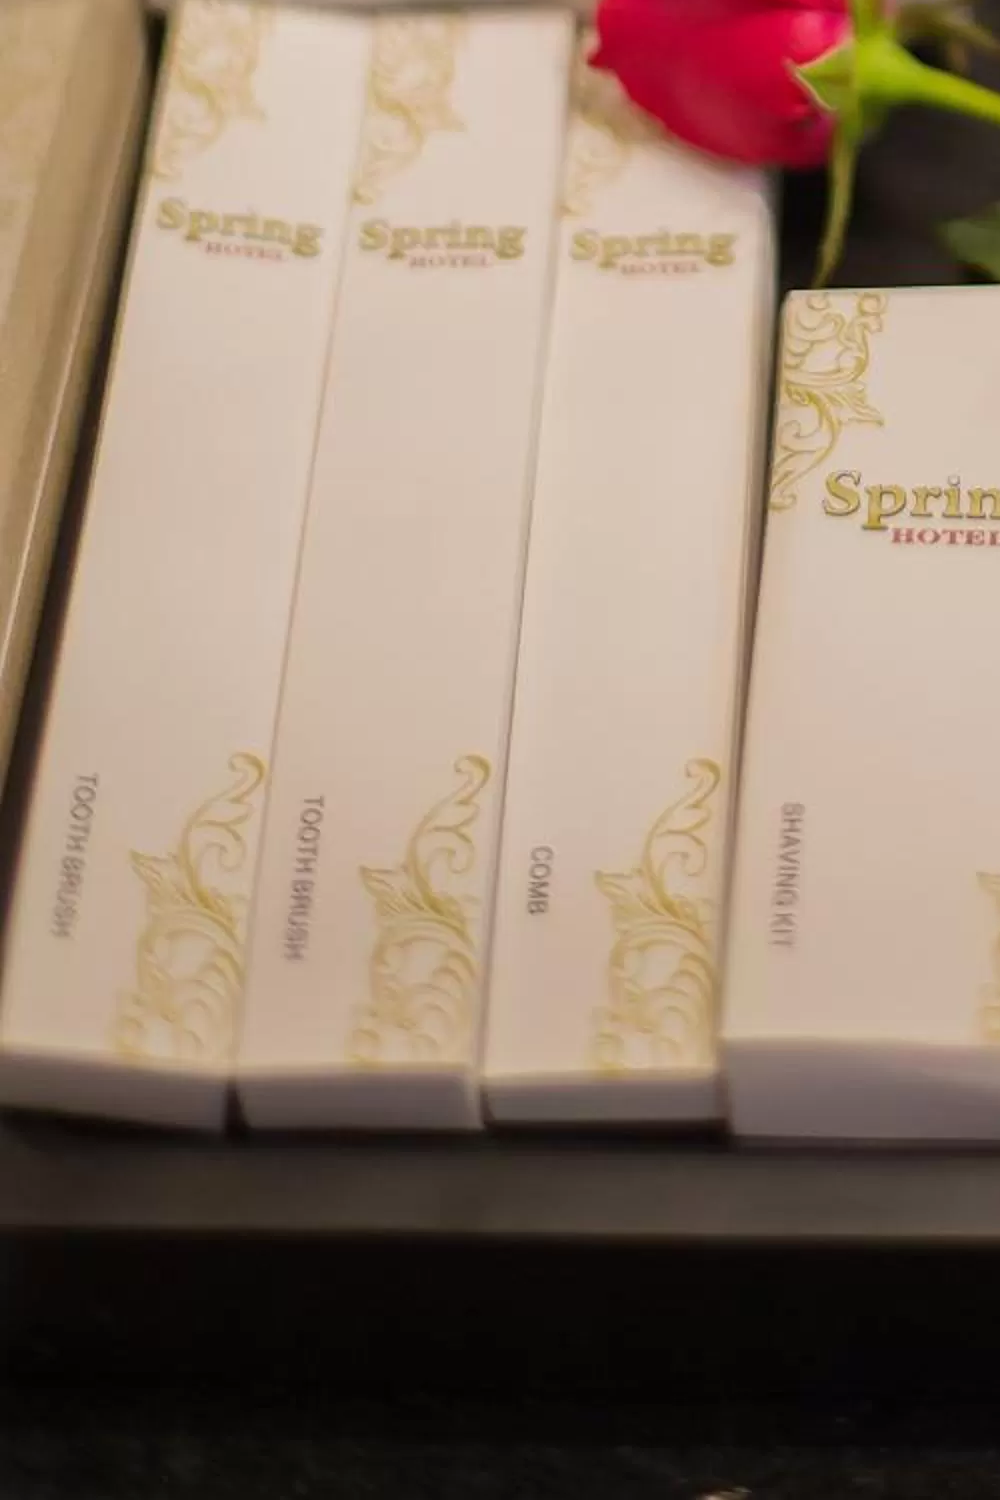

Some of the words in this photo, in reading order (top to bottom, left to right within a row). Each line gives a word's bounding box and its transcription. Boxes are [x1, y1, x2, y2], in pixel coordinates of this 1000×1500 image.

[156, 197, 325, 257] Spring
[359, 219, 526, 260] Spring
[570, 226, 738, 267] Spring
[205, 241, 286, 263] HOTEL
[408, 255, 494, 269] HOTEL
[619, 263, 701, 275] HOTEL
[65, 773, 98, 852] TOOTH
[295, 796, 325, 873] TOOTH
[774, 802, 804, 905] SHAVING
[527, 845, 553, 915] COMB
[769, 912, 796, 948] KIT
